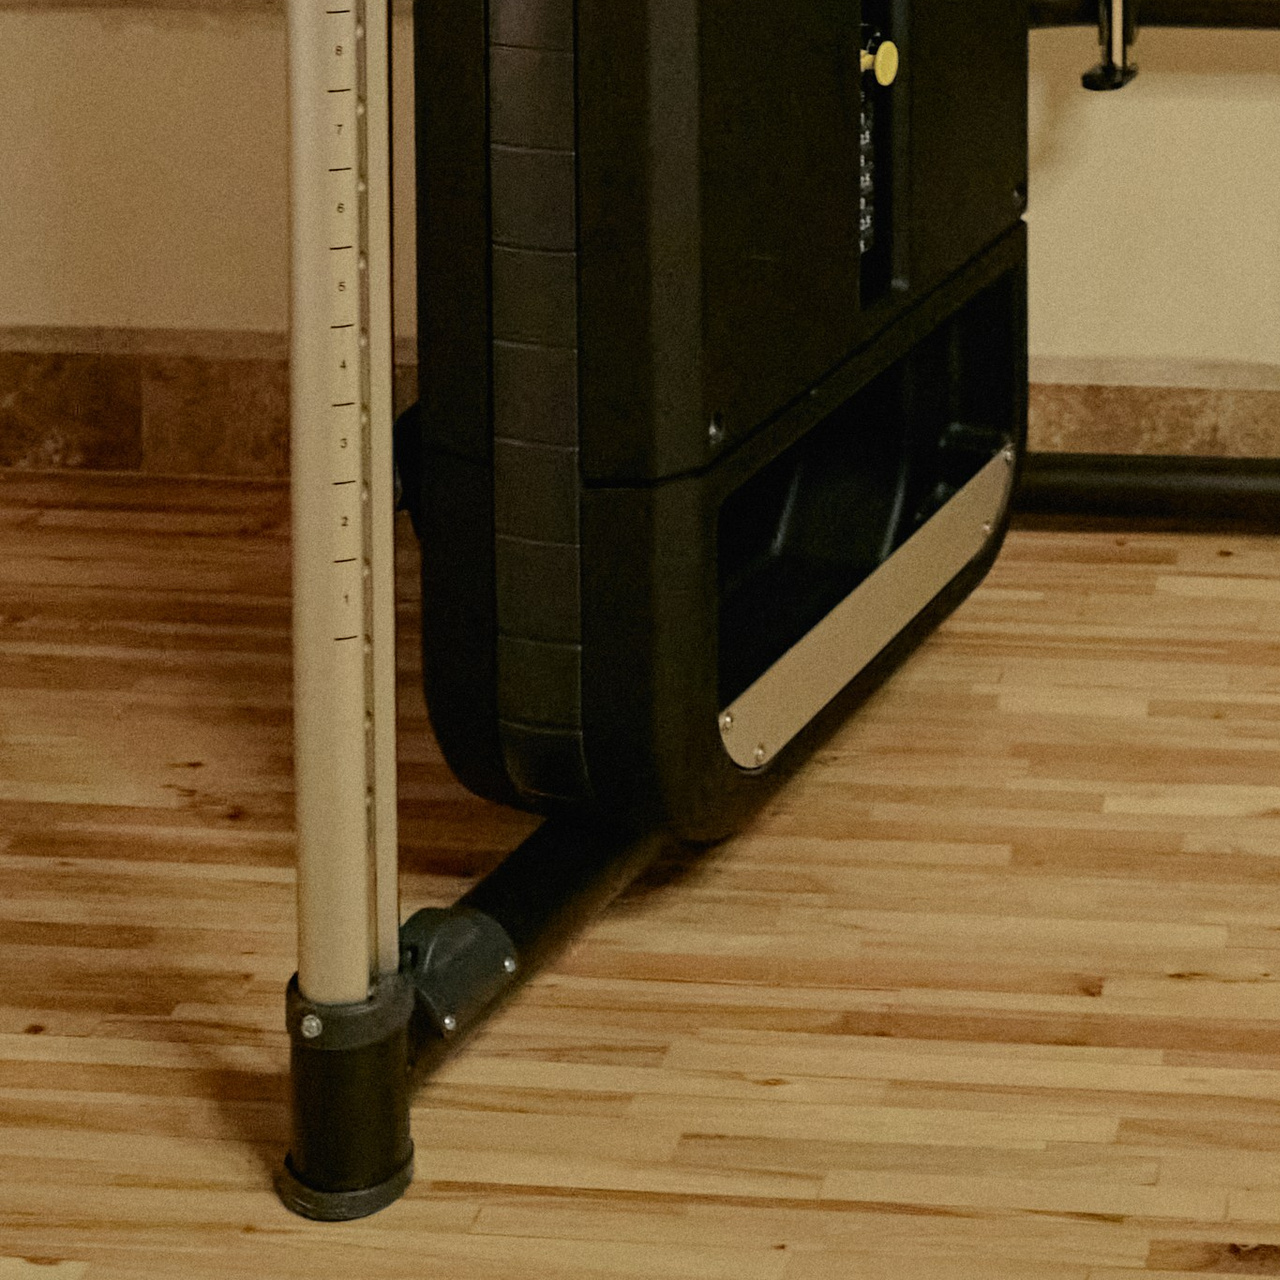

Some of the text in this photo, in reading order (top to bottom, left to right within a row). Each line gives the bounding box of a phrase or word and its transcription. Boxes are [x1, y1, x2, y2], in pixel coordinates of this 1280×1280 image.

[335, 45, 343, 56] 8
[337, 203, 345, 213] 6
[338, 281, 346, 292] 5
[340, 360, 347, 369] 4
[340, 438, 348, 449] 3
[341, 516, 348, 527] 2
[343, 594, 349, 604] 1
